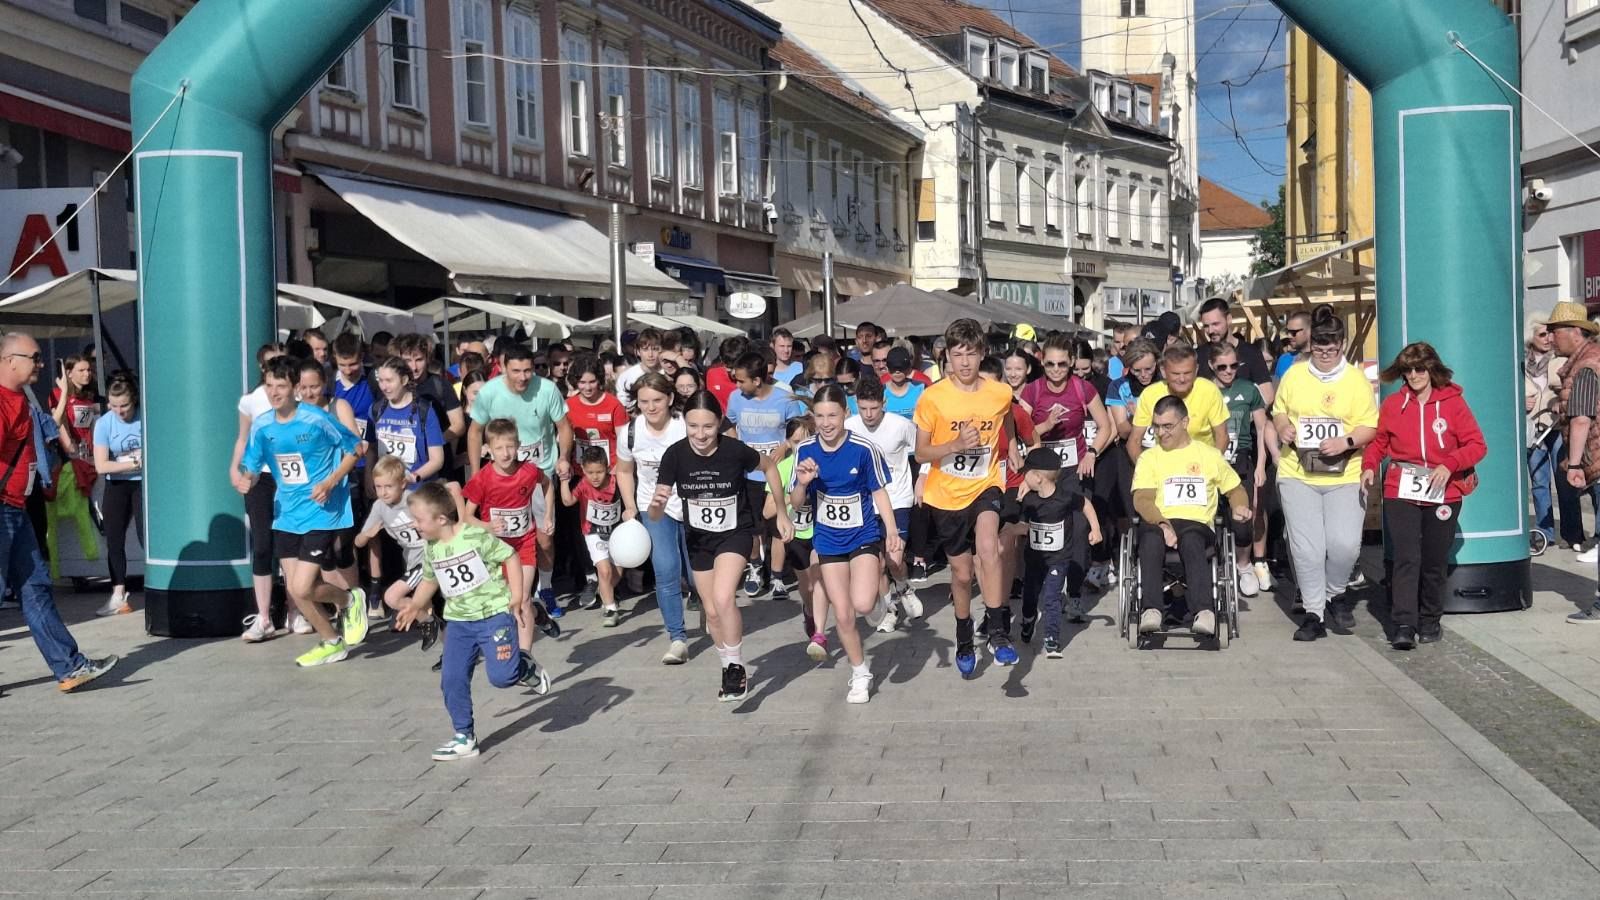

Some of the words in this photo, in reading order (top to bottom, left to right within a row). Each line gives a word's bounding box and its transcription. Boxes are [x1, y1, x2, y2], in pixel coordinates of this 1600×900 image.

[9, 203, 79, 279] A1
[980, 421, 993, 431] 22
[1303, 424, 1338, 440] 300
[386, 440, 405, 456] 39
[281, 462, 301, 478] 59
[953, 455, 980, 472] 87
[1174, 484, 1197, 499] 78
[592, 509, 617, 522] 123
[701, 508, 726, 525] 89
[826, 505, 851, 521] 88
[1033, 530, 1055, 544] 15
[444, 564, 474, 588] 38
